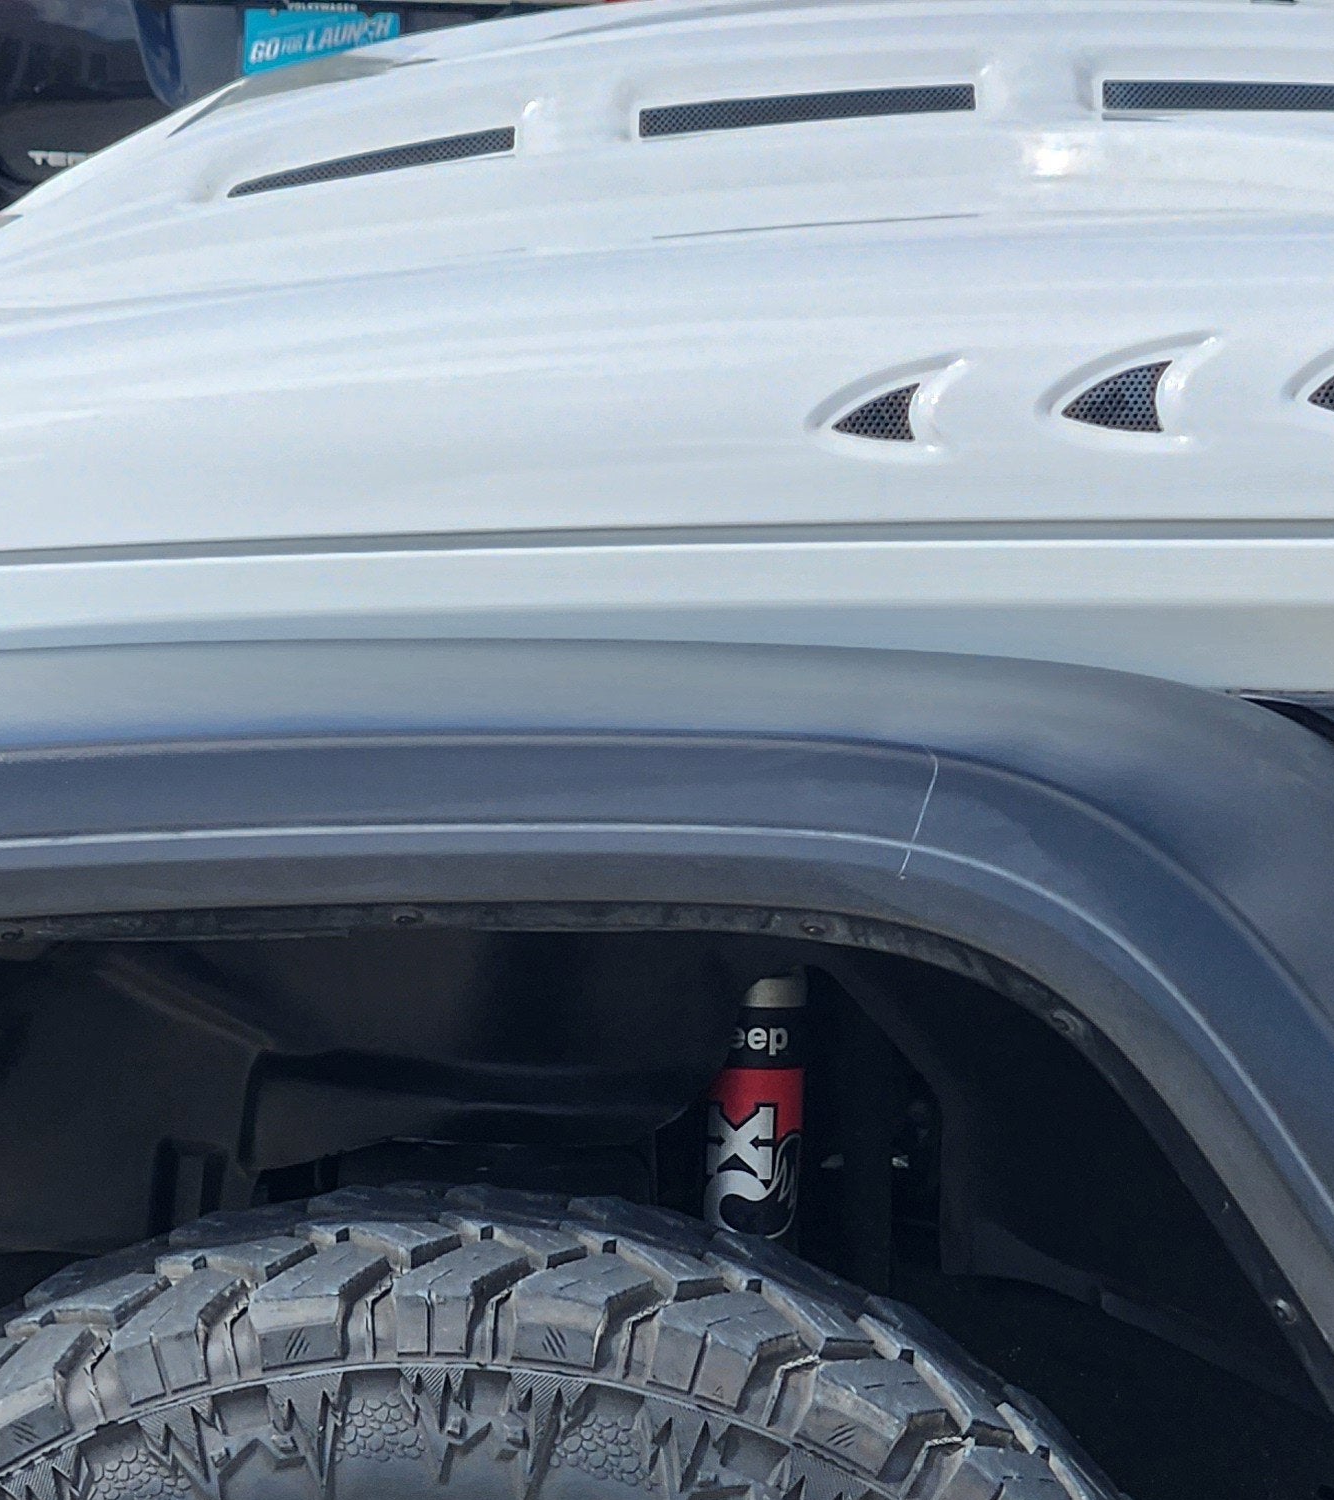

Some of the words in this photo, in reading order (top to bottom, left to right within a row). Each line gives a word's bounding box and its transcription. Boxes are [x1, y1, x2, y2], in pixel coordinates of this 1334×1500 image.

[287, 2, 358, 12] VOLKSWAGEN
[250, 37, 280, 64] GO
[729, 1026, 788, 1056] eep
